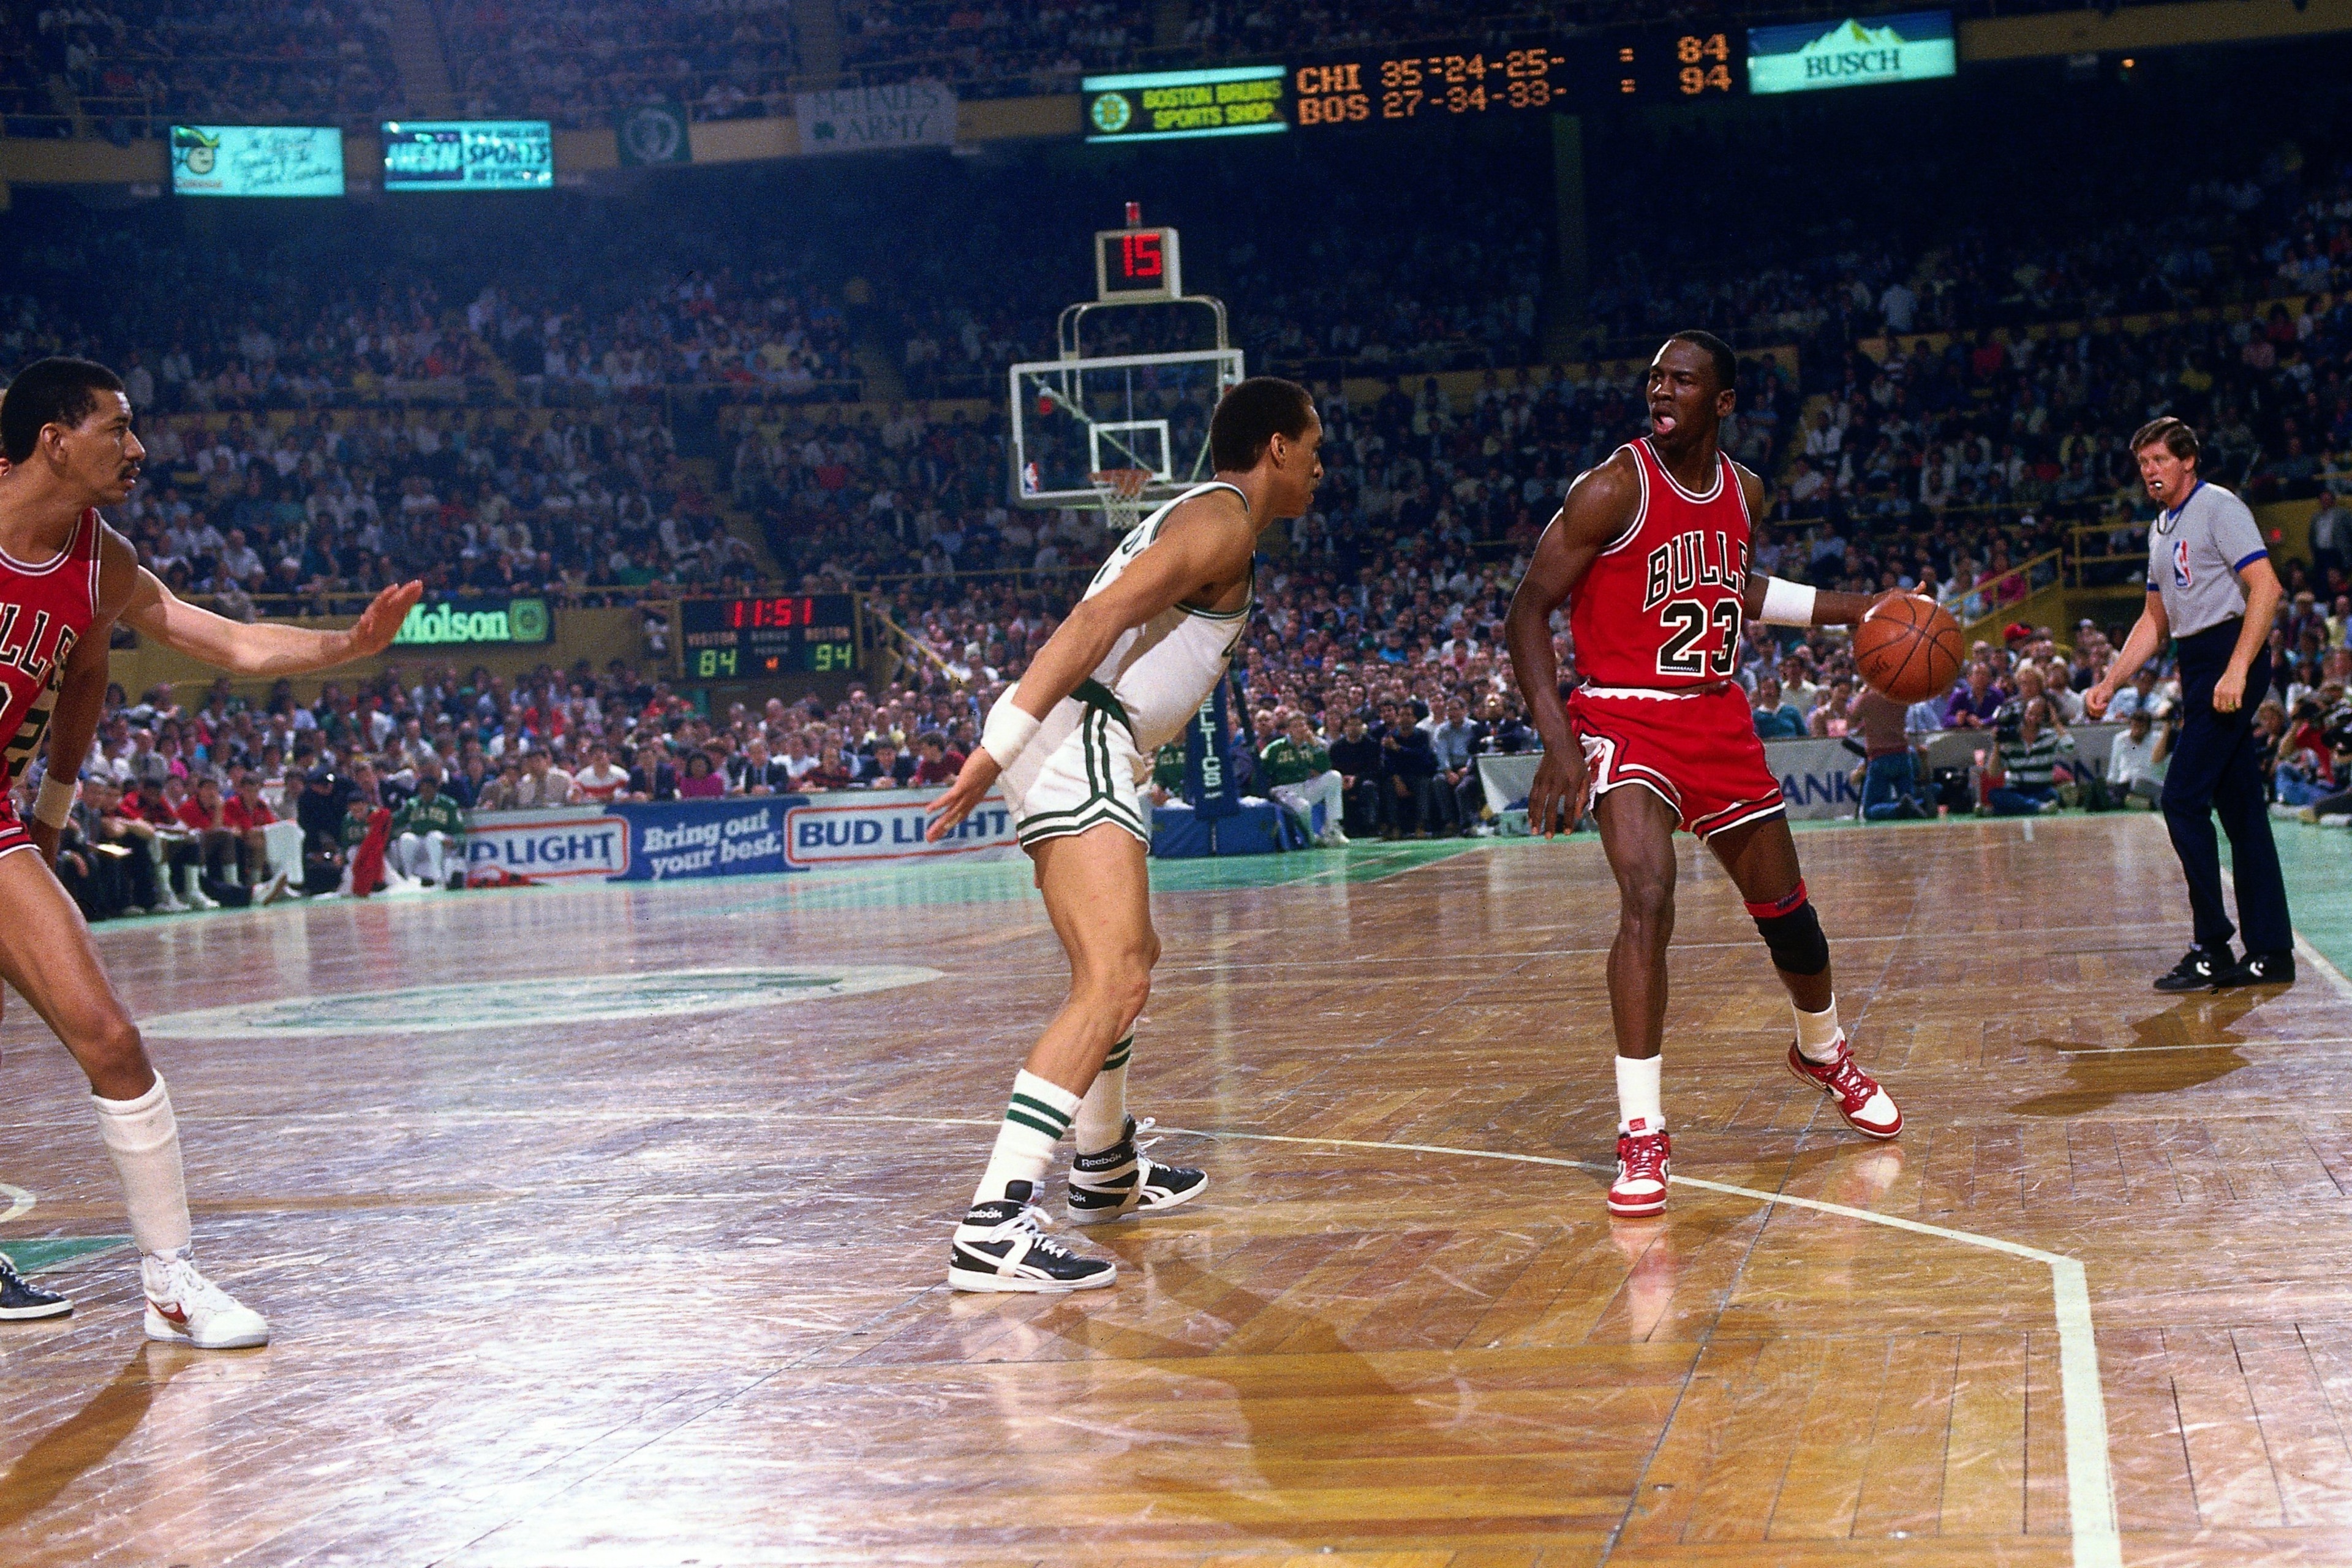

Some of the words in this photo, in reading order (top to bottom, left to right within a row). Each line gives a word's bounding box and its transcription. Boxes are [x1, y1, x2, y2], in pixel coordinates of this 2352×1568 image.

[1296, 64, 1360, 94] CHI
[1677, 34, 1730, 63] 84
[1805, 48, 1901, 78] BUSCH
[1143, 86, 1213, 109] BOSTON
[1216, 80, 1282, 104] BRUINS
[1298, 94, 1370, 125] BOS
[1679, 64, 1733, 94] 94
[844, 112, 929, 142] ARMY
[1153, 106, 1223, 130] SPORTS
[1226, 102, 1275, 124] SHOP
[1123, 234, 1162, 276] 15
[733, 598, 813, 628] 11:51
[1656, 598, 1742, 677] 23
[699, 648, 737, 677] 84
[816, 644, 853, 671] 94
[1199, 691, 1222, 786] ELTICS
[1779, 770, 1859, 806] ANK
[643, 823, 722, 852] Bring
[725, 807, 770, 837] out
[799, 820, 883, 848] BUD
[506, 832, 614, 864] LIGHT
[650, 848, 716, 881] your
[1081, 1153, 1122, 1167] Reebok
[967, 1207, 1003, 1219] eebok
